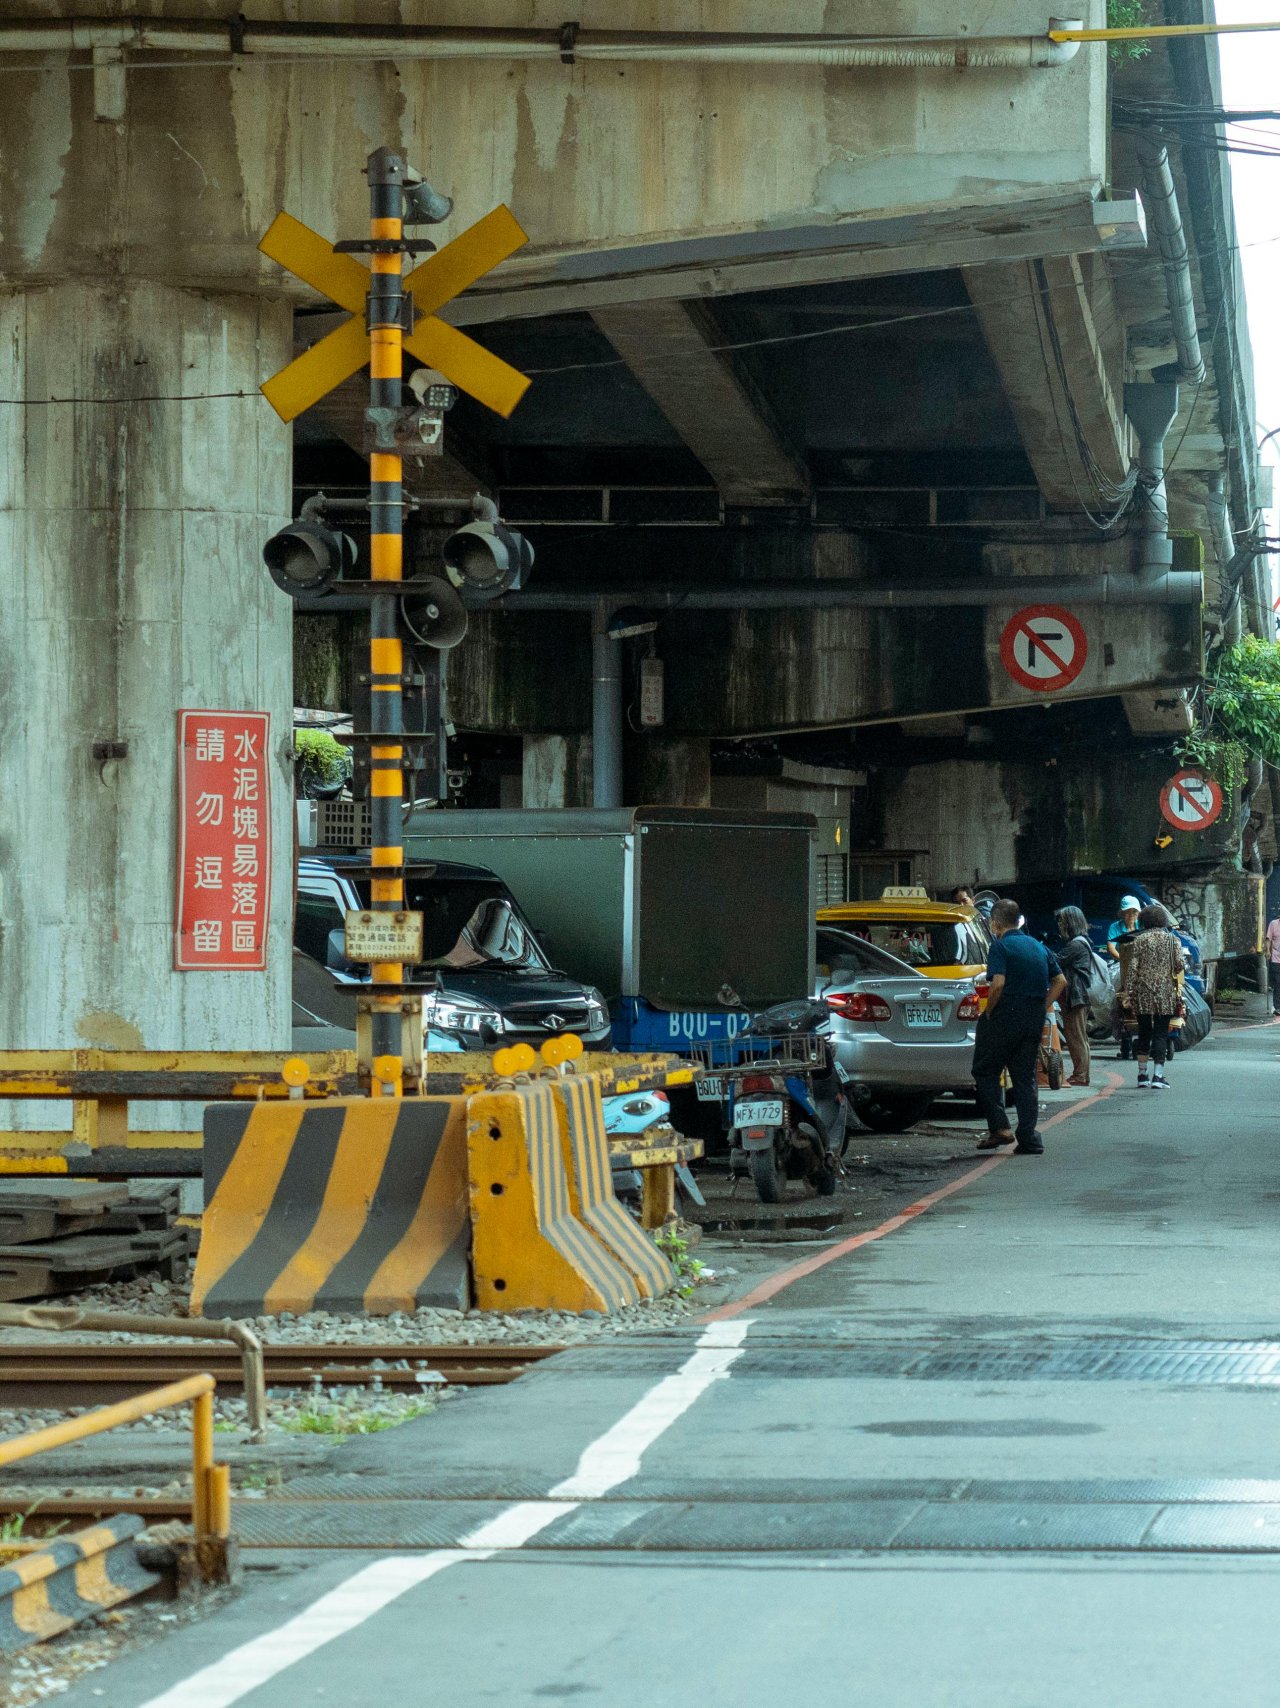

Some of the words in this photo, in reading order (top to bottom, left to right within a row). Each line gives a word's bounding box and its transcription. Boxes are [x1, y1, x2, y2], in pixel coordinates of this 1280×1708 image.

[192, 728, 226, 953] 請勿逗留
[232, 728, 260, 954] 水泥塊易落區
[887, 888, 921, 896] TAXI
[907, 1008, 942, 1023] BFR-2602
